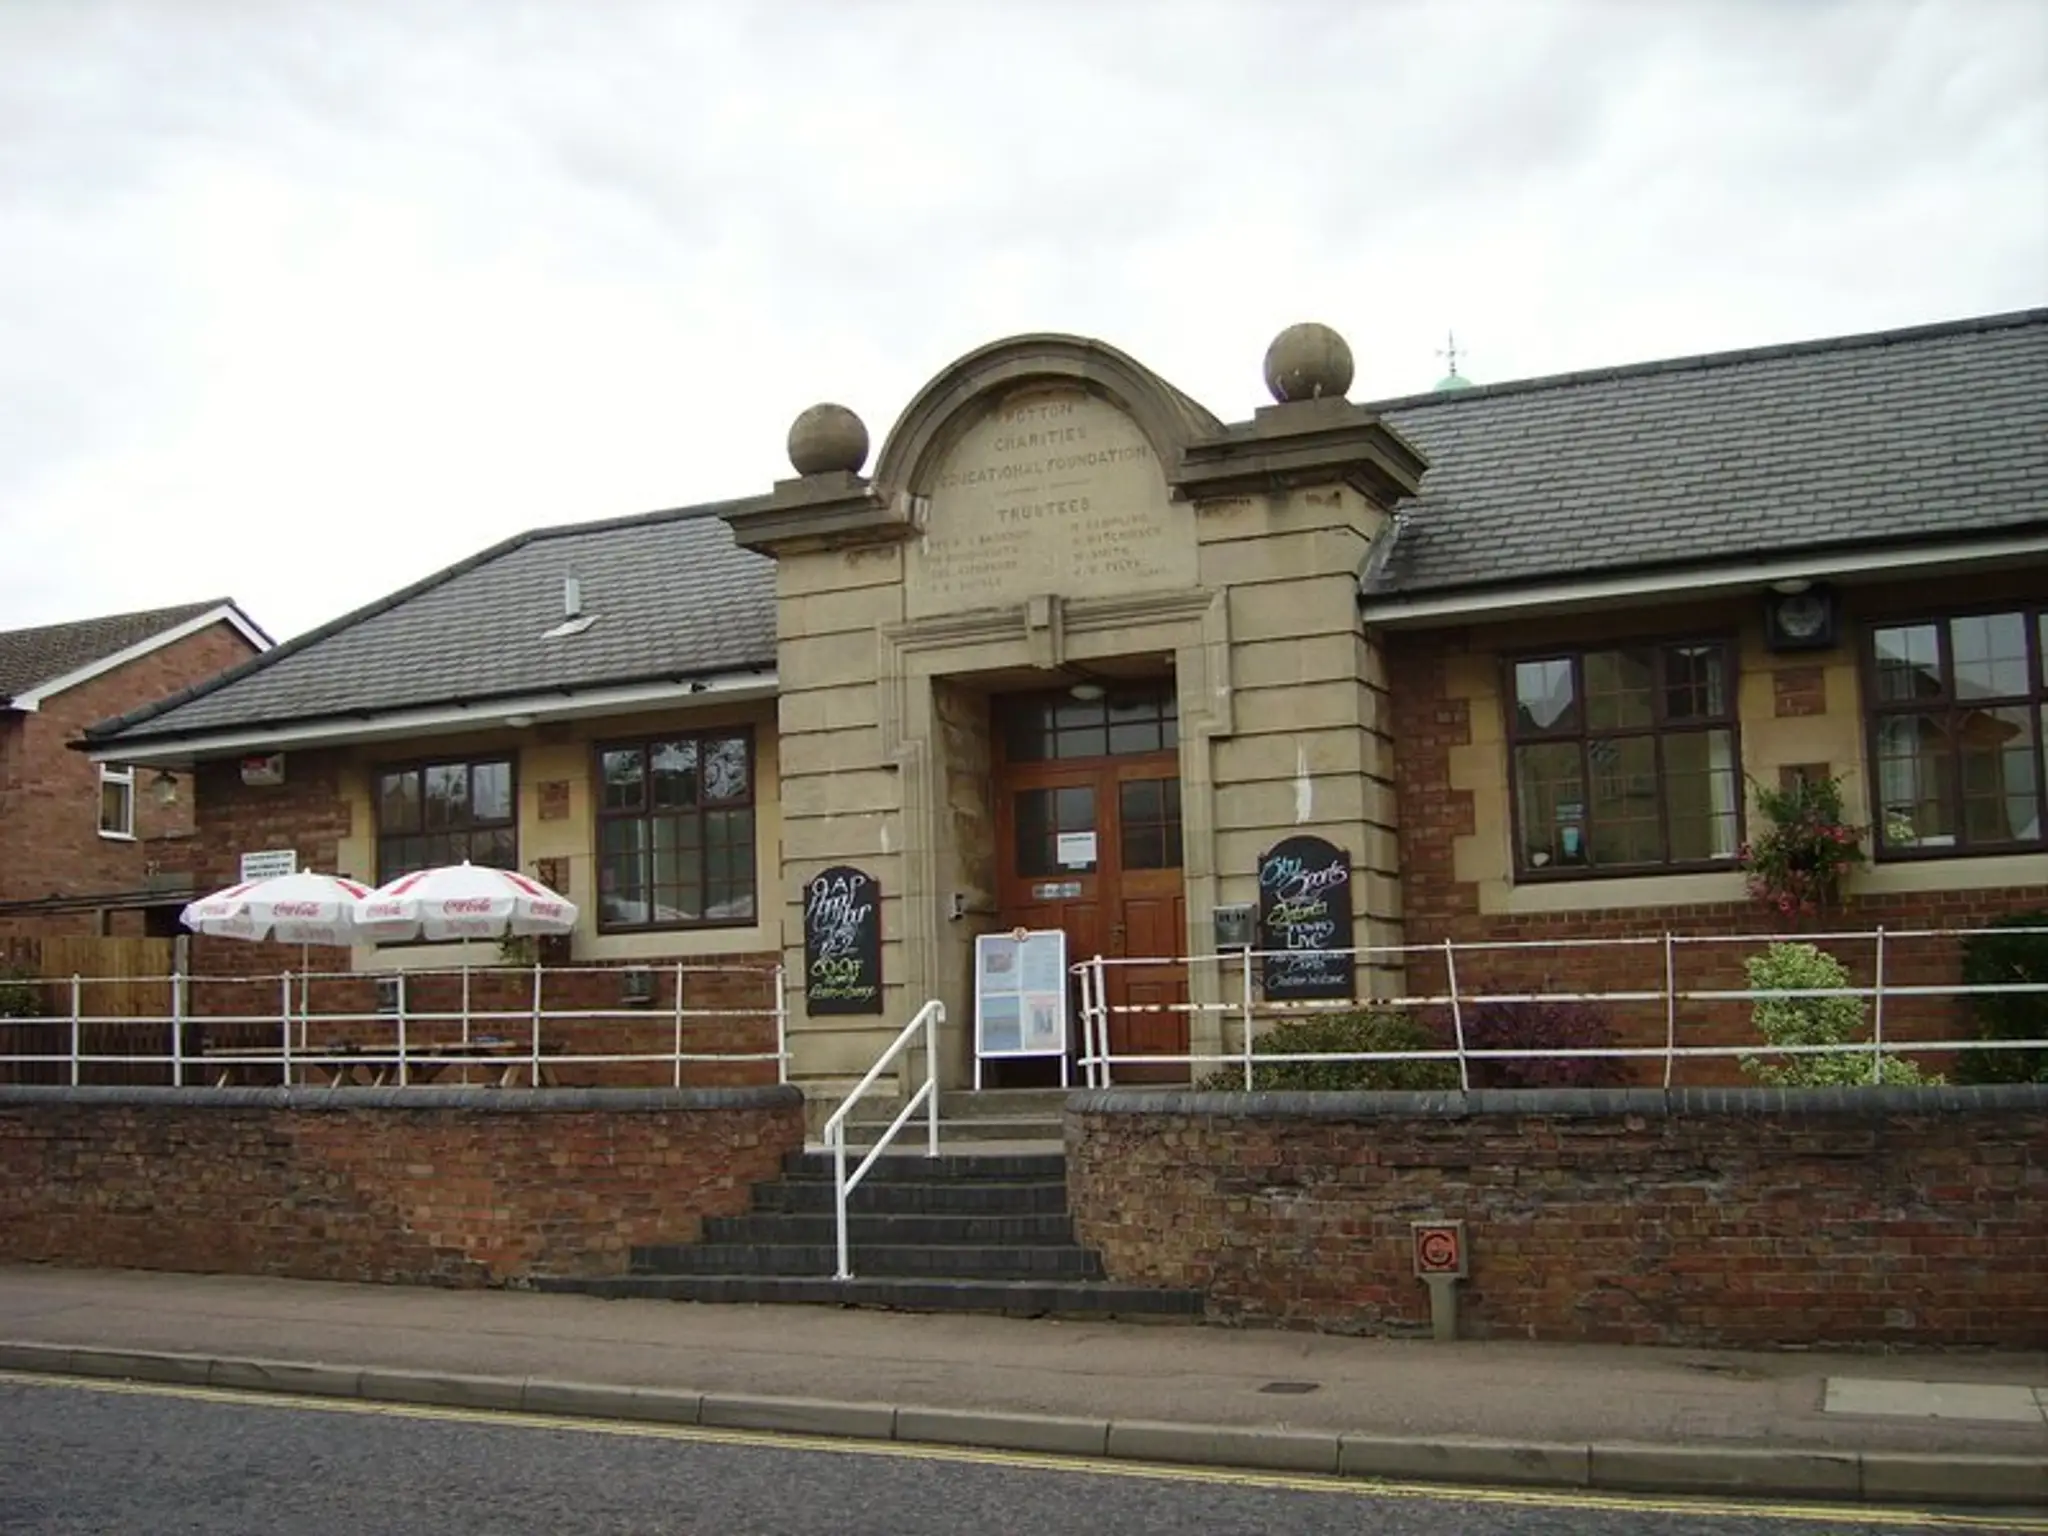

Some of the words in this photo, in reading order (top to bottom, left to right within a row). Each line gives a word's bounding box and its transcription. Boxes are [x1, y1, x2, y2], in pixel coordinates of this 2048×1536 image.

[994, 427, 1087, 452] CHARITIES
[1047, 445, 1147, 472] FOUNDATION
[997, 497, 1090, 524] TRUSTEES
